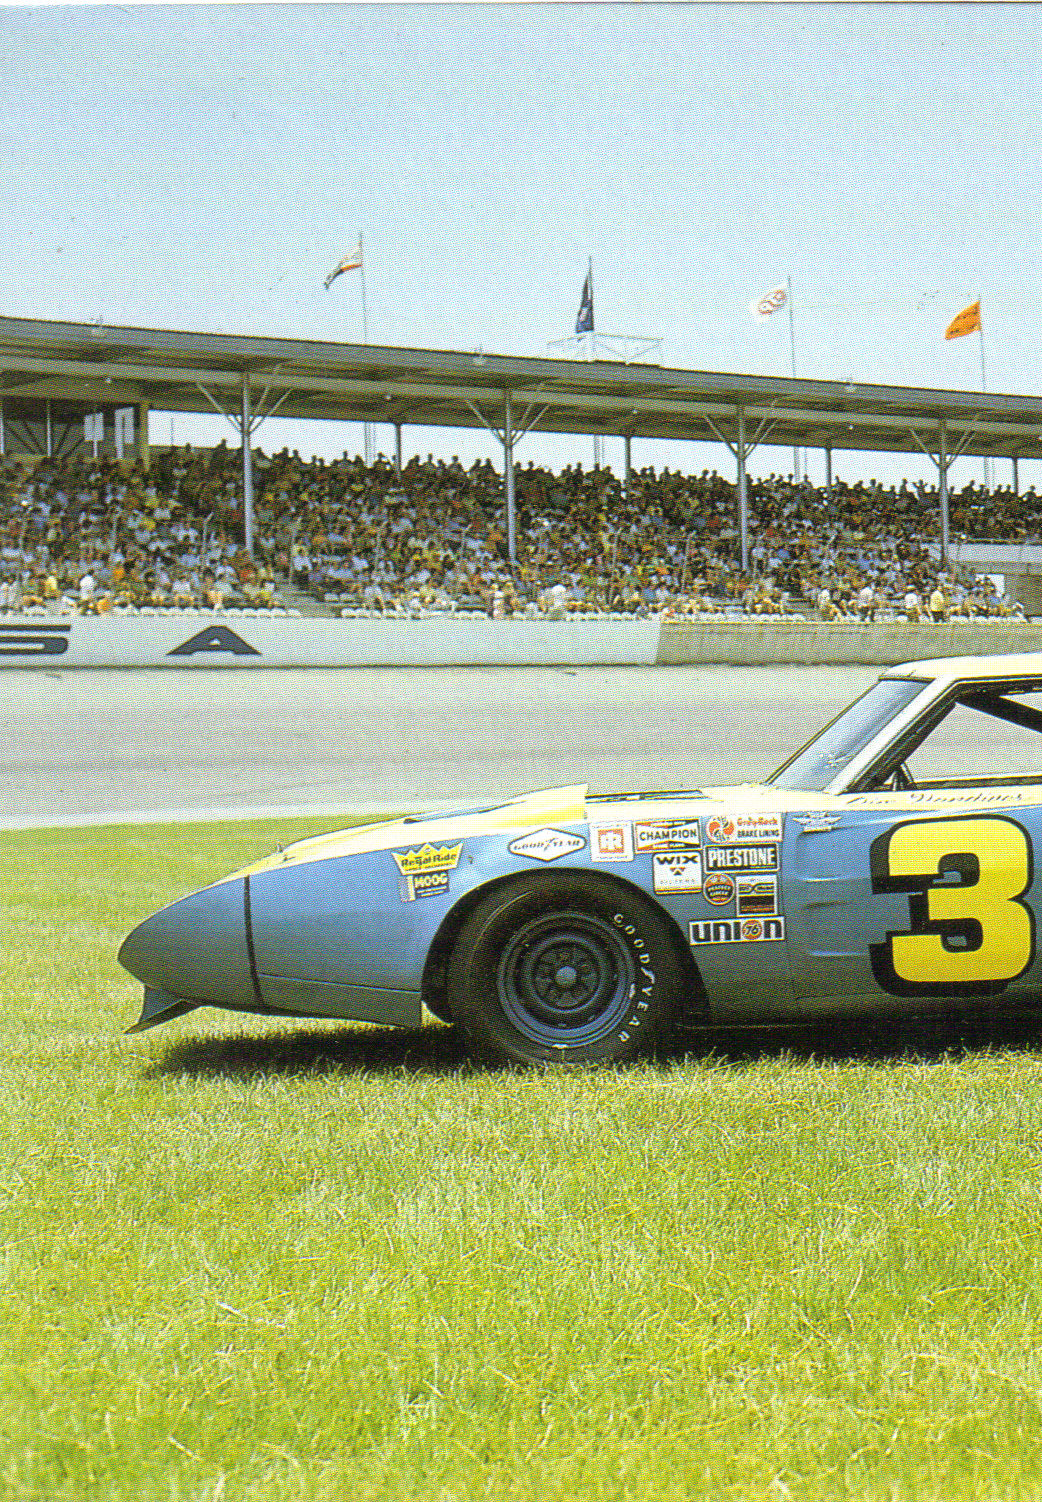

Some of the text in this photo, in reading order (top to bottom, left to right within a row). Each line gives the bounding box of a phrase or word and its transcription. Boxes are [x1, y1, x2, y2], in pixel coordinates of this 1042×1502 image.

[638, 828, 698, 842] CHAMPION
[432, 851, 458, 865] Ride
[655, 855, 699, 866] WIX
[707, 847, 777, 869] PRESTONE
[414, 872, 449, 889] MOOG
